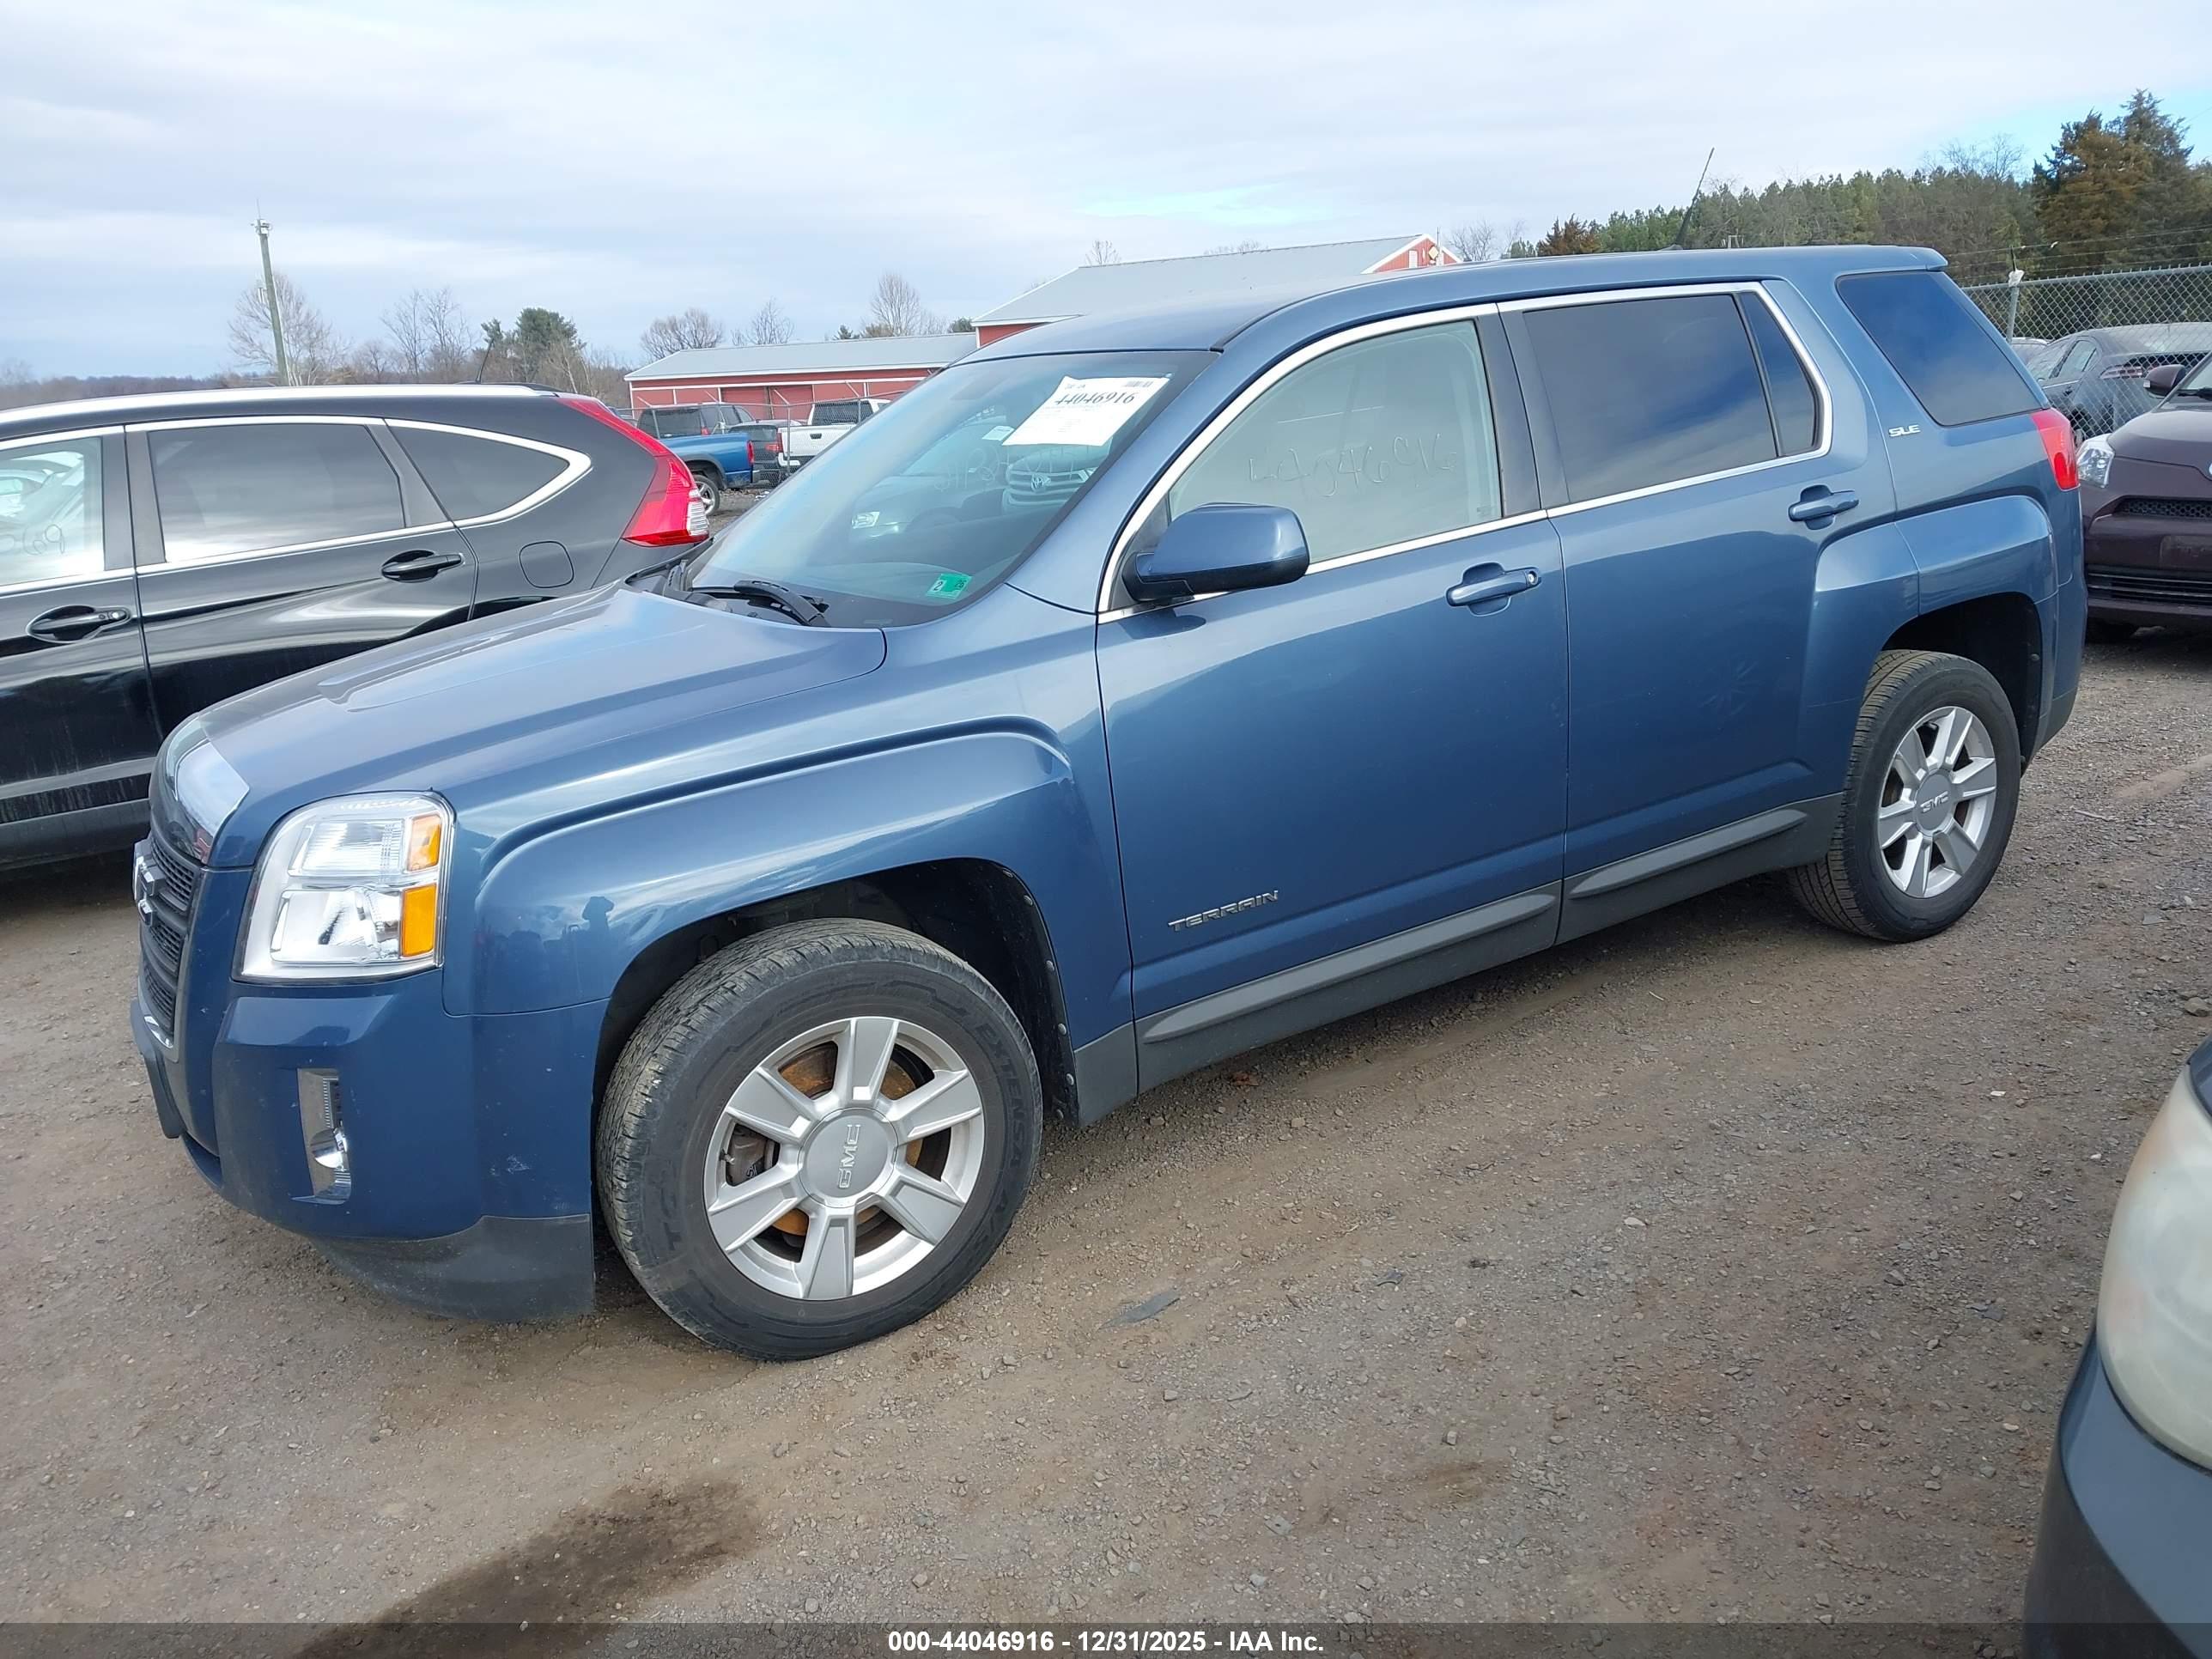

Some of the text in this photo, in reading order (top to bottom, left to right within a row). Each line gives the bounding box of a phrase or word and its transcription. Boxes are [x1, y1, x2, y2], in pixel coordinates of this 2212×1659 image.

[1054, 391, 1138, 405] 44046916
[1888, 424, 1922, 438] SLE
[1167, 889, 1279, 933] TERRAIN
[838, 1123, 861, 1189] GMC
